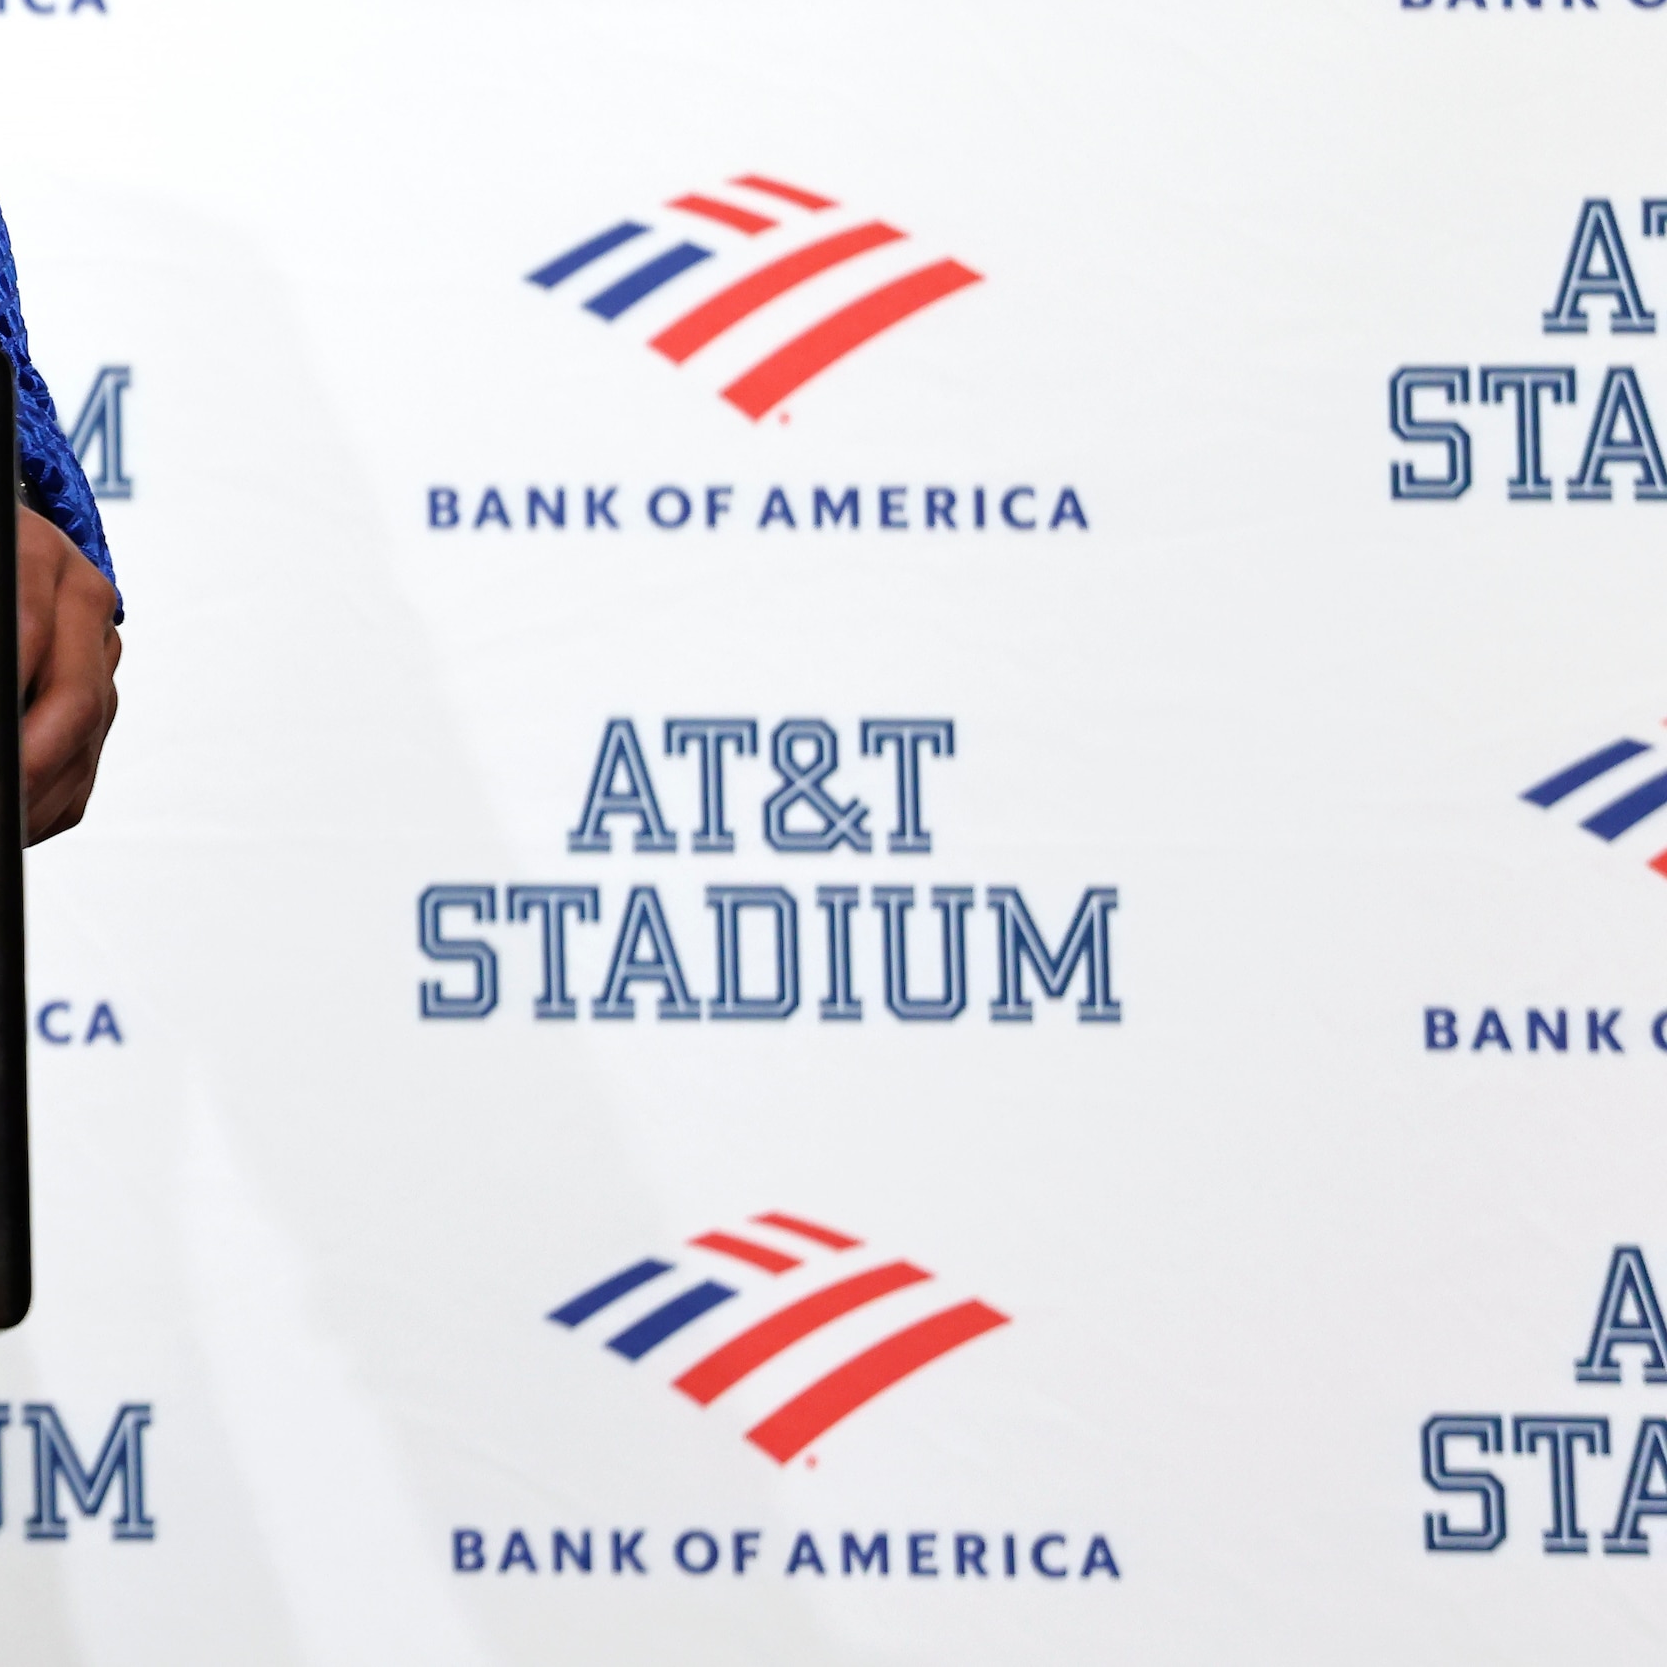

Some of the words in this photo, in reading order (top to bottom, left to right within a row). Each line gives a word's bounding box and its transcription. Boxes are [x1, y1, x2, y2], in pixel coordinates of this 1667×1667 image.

[1543, 199, 1667, 334] A
[428, 488, 618, 528] BANK
[647, 487, 731, 529] OF
[759, 486, 1088, 530] AMERICA
[569, 718, 955, 854] AT&T
[418, 885, 1121, 1023] STADIUM
[1425, 1008, 1623, 1052] BANK
[453, 1529, 646, 1574] BANK
[674, 1530, 760, 1574] OF
[786, 1532, 1120, 1578] AMERICA
